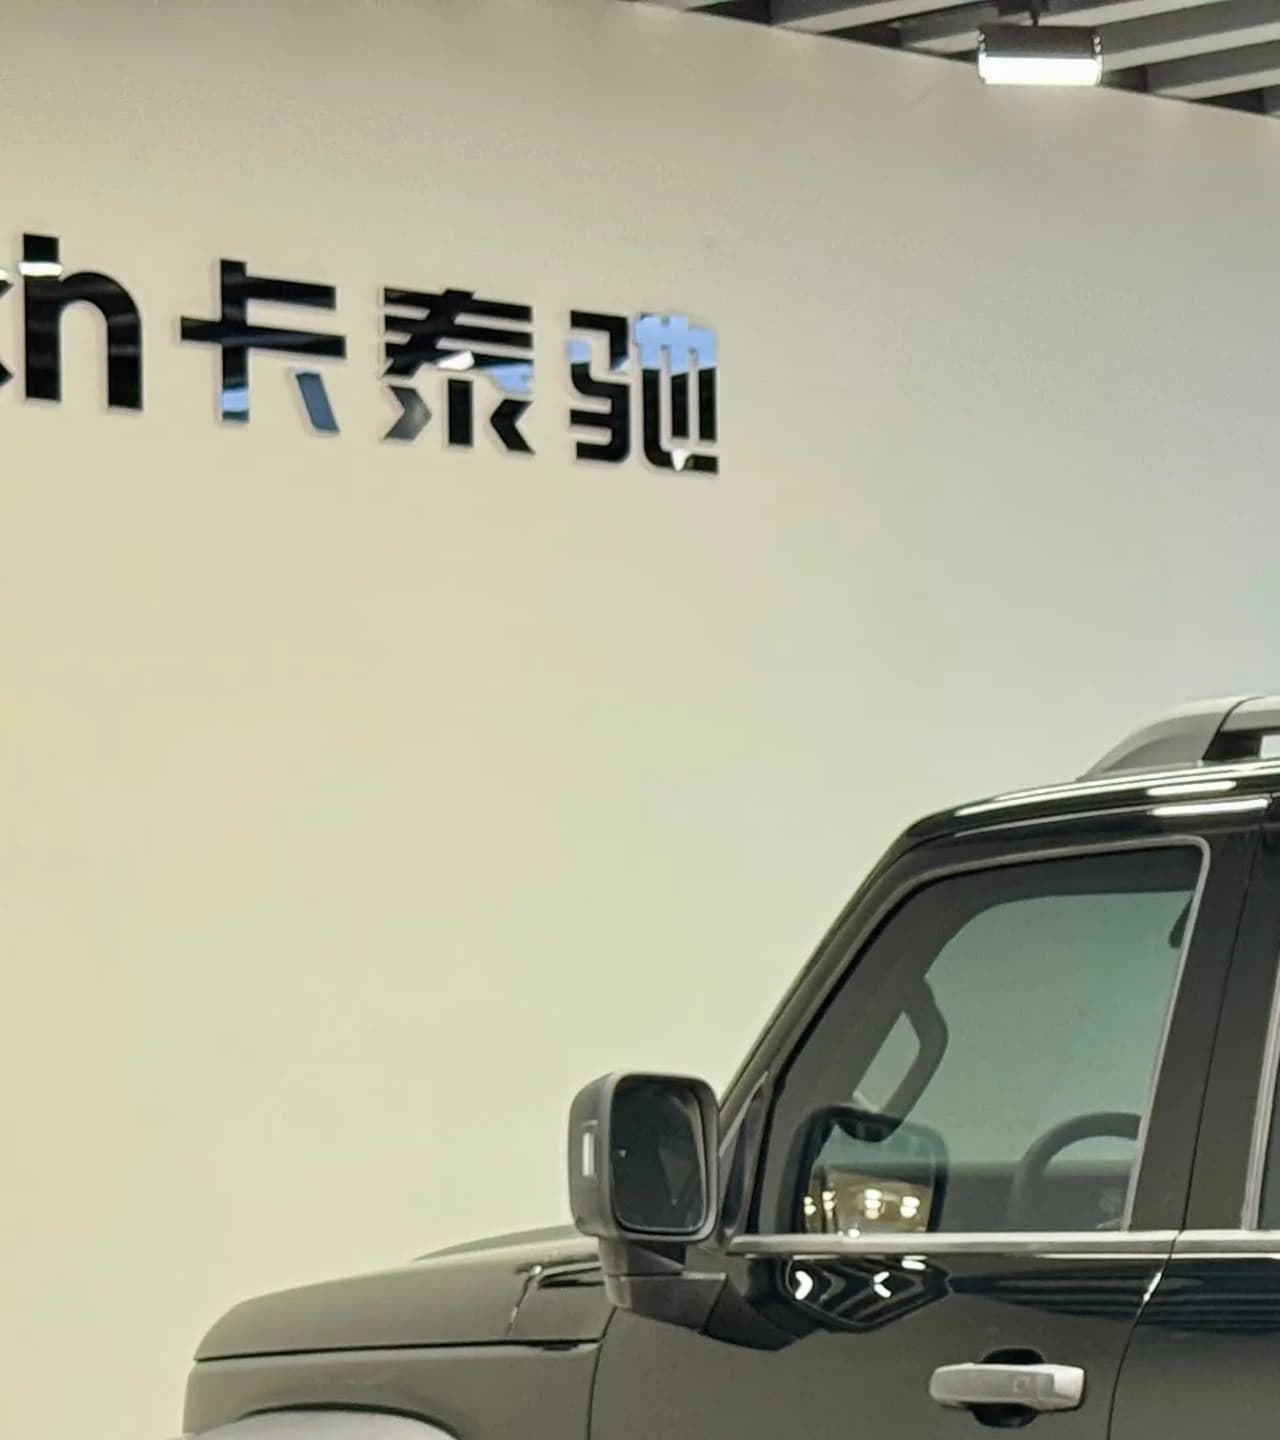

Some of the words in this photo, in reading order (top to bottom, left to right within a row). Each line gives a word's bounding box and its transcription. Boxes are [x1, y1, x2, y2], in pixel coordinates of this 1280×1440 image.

[0, 233, 143, 411] h
[179, 258, 719, 474] 卡泰驰
